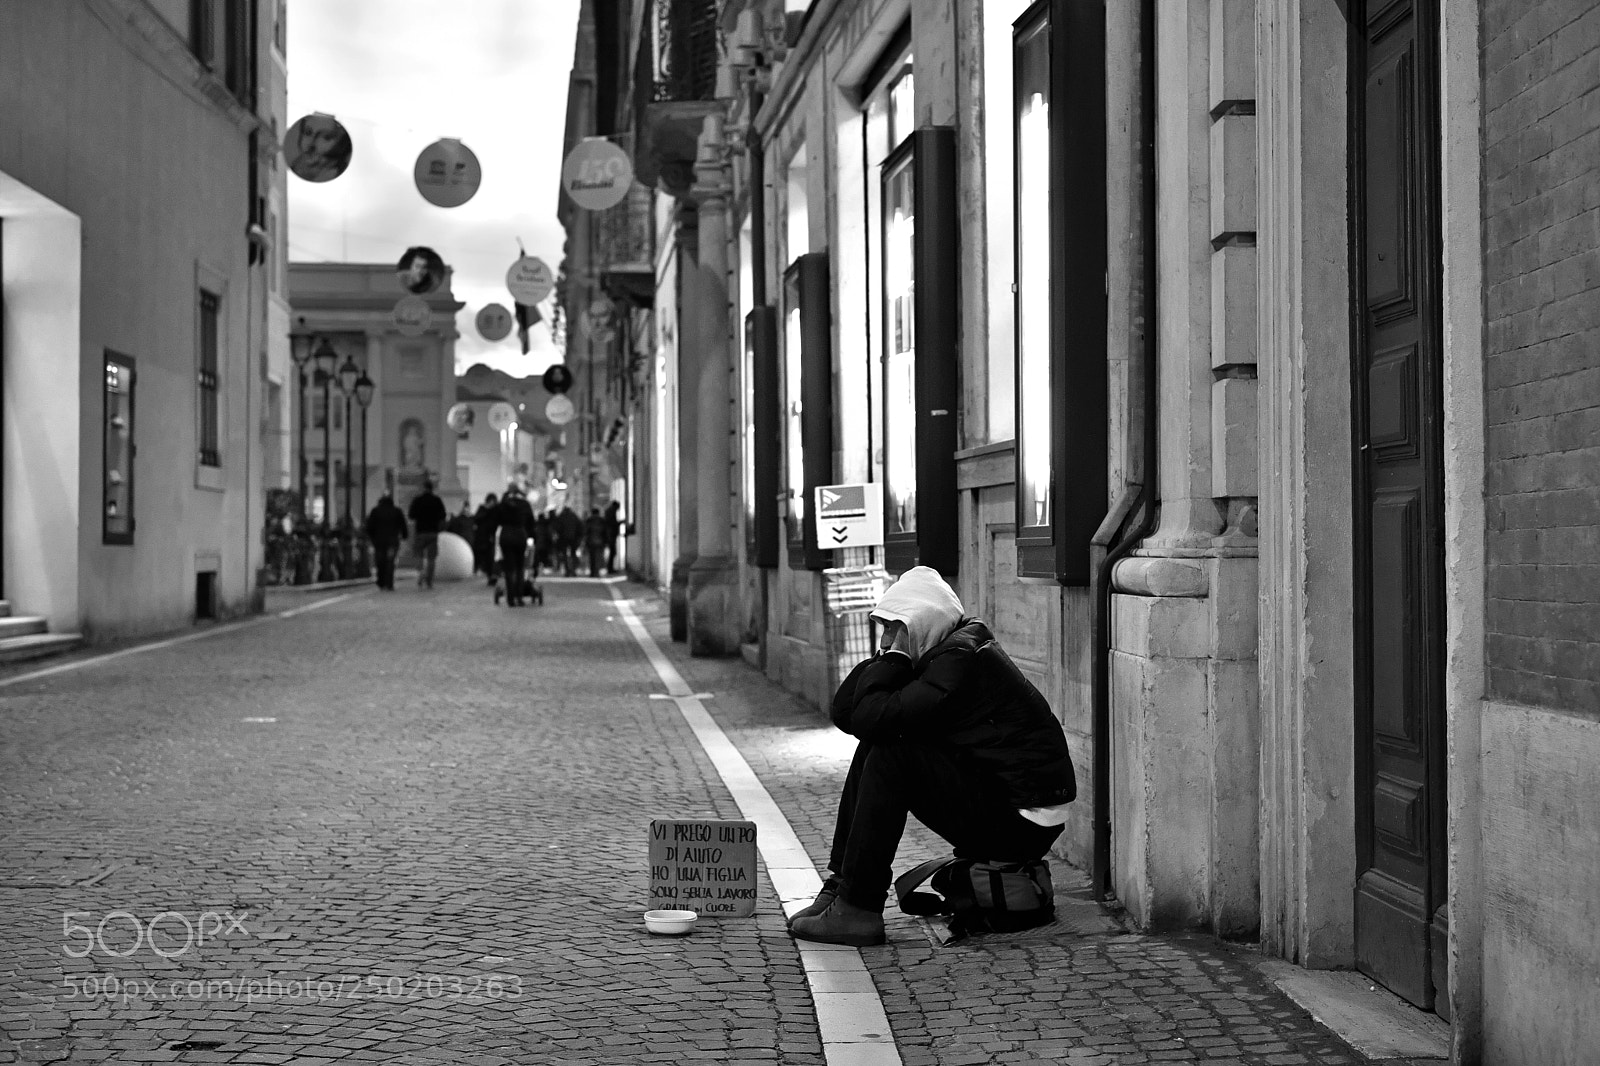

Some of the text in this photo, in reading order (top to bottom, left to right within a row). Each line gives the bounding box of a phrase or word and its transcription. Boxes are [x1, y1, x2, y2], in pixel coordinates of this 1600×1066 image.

[650, 820, 666, 840] VI
[674, 824, 711, 841] PREGO
[719, 826, 735, 843] UN
[664, 847, 722, 863] DI AIUTO
[652, 865, 746, 882] HO UNA FIGLIA
[682, 886, 713, 899] SENZA
[717, 888, 757, 900] LAVORO
[705, 902, 736, 913] CUORE
